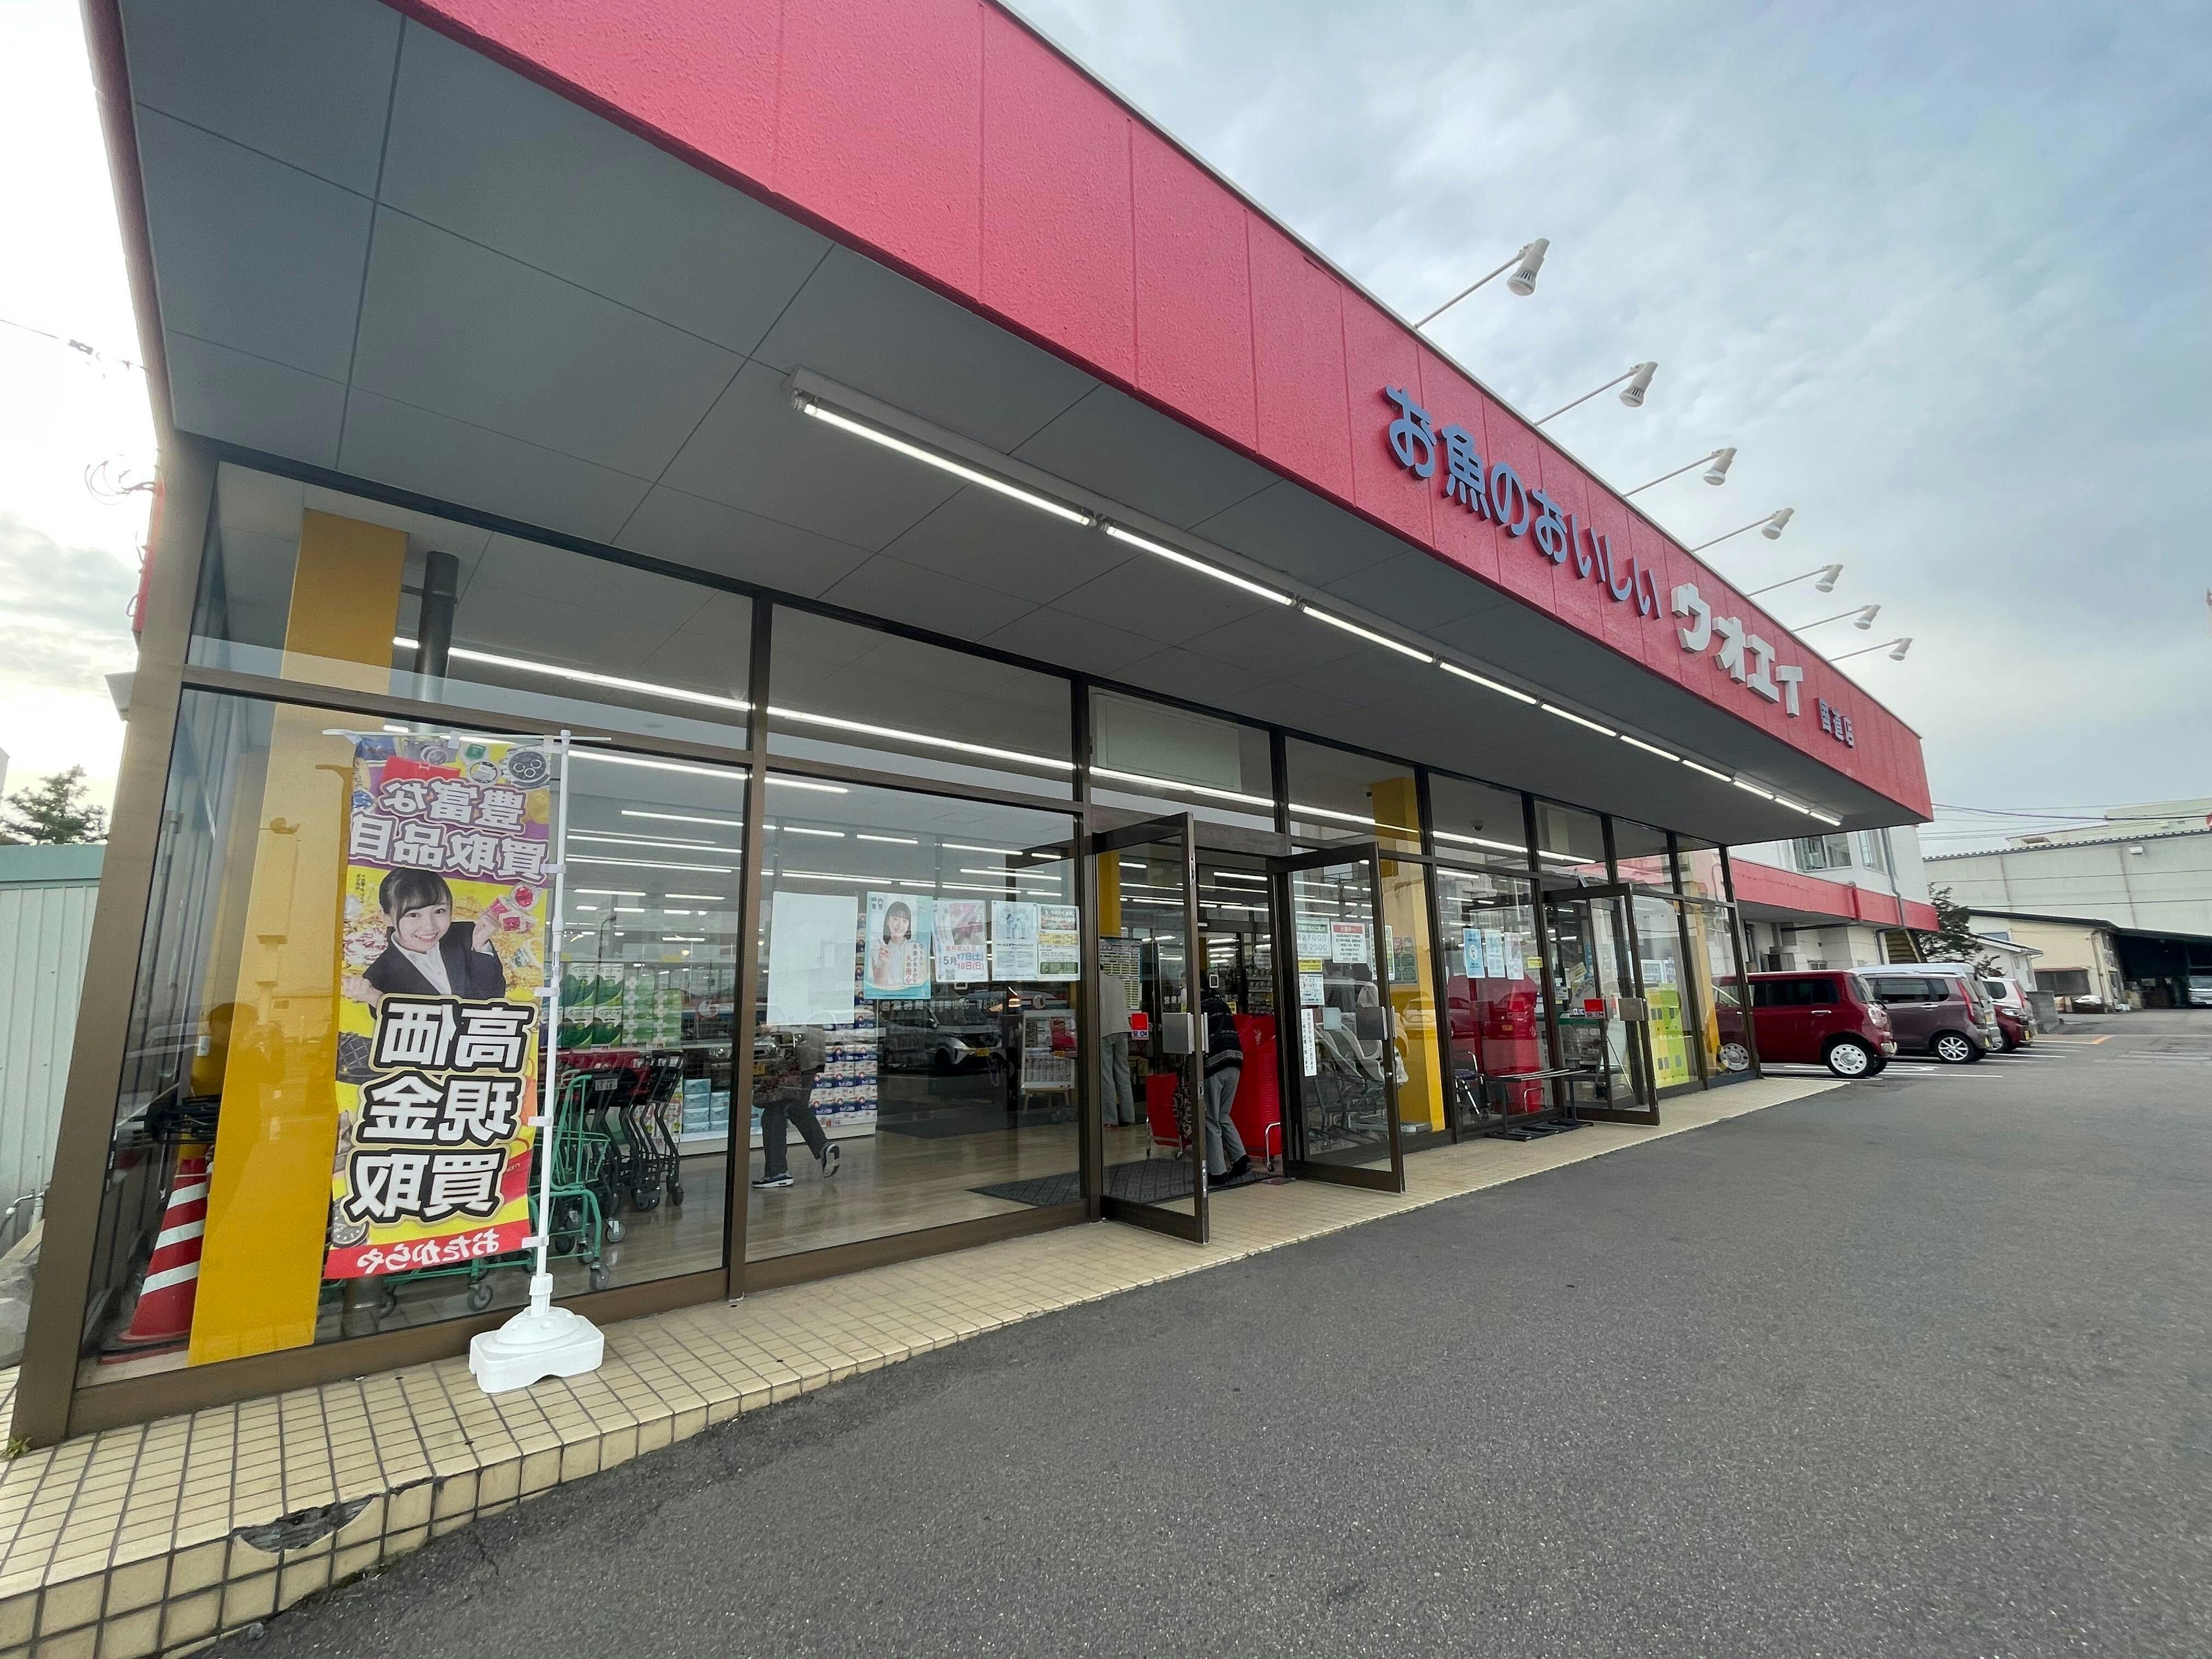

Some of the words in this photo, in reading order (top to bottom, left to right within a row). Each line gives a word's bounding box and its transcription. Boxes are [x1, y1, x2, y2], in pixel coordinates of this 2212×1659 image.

[1385, 384, 1661, 619] お魚のおいしい
[1671, 582, 1803, 718] ウオエイ
[944, 956, 957, 966] 5月
